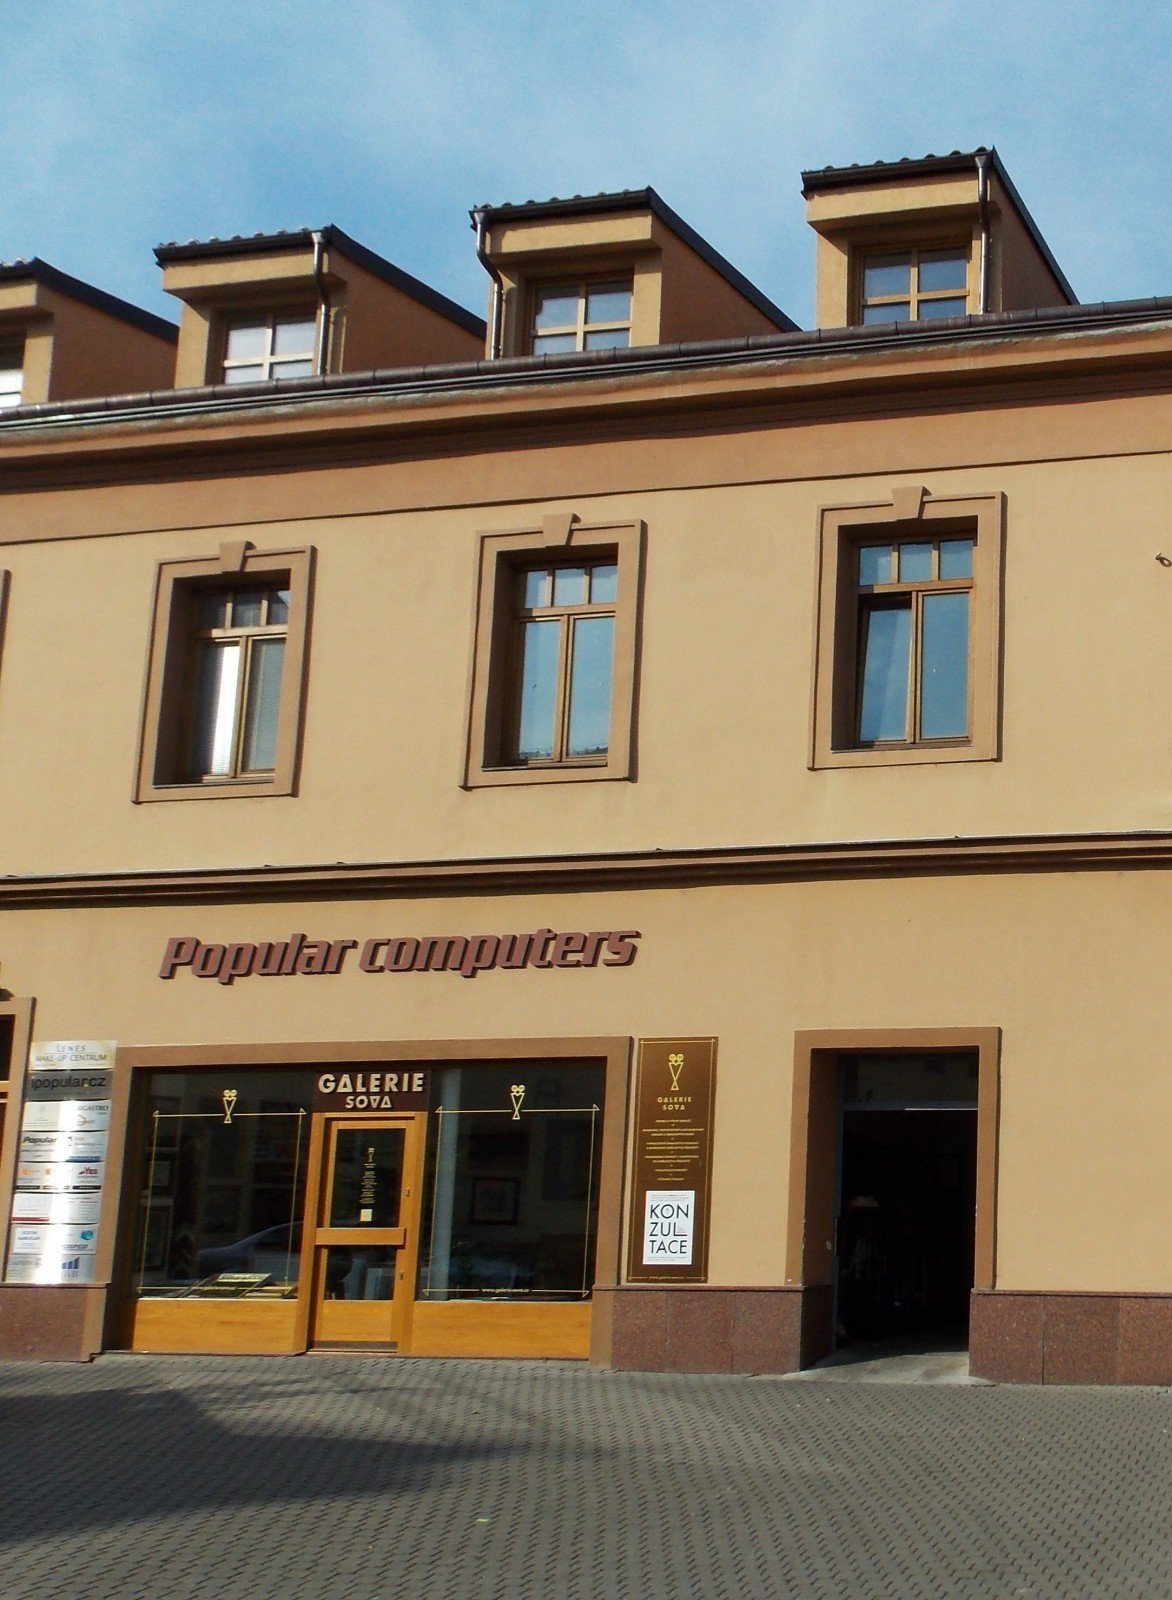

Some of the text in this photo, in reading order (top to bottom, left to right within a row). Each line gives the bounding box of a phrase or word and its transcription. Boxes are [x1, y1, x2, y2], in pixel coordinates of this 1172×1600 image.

[159, 927, 642, 985] Popular computers
[318, 1073, 424, 1093] GALERIE
[345, 1095, 392, 1109] SOVA
[650, 1204, 689, 1219] KON
[649, 1222, 688, 1237] ZUL
[649, 1240, 688, 1254] TACE
